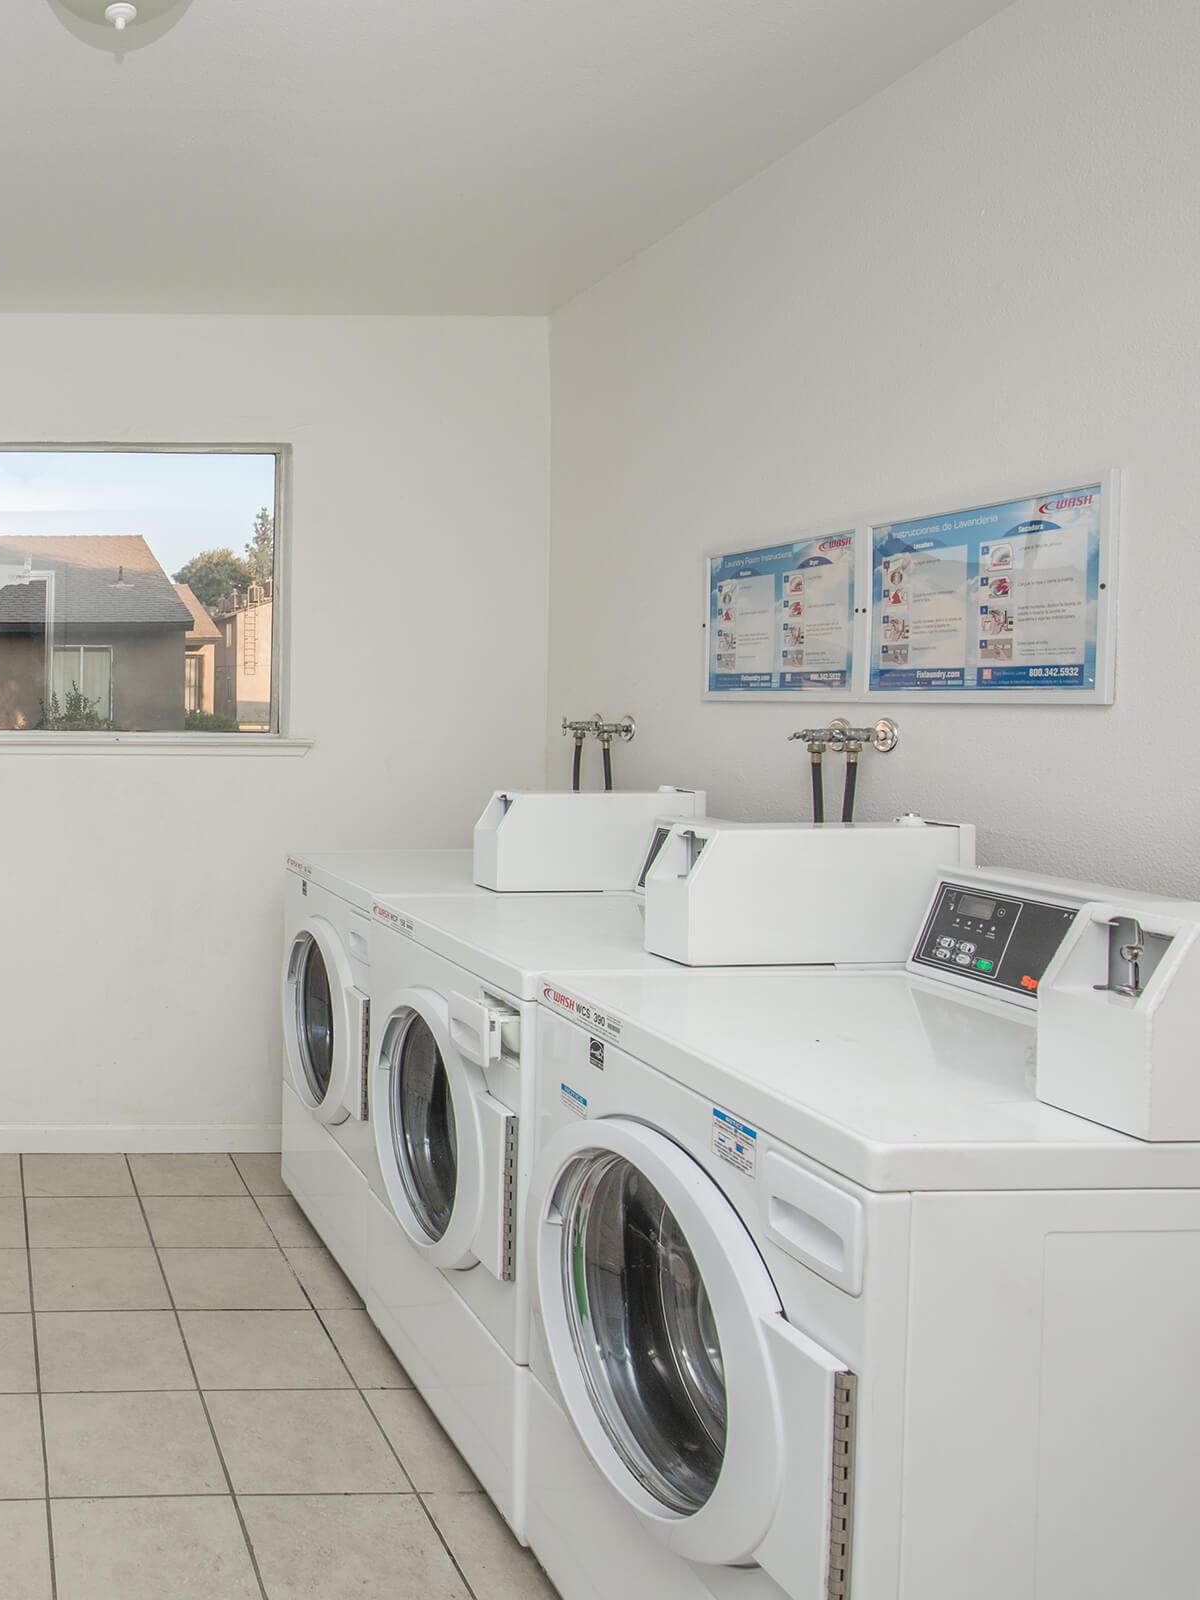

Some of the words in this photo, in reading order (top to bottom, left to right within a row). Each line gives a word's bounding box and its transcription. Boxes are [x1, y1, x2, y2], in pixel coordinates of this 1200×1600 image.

[1056, 494, 1093, 509] WASH
[942, 521, 952, 531] de
[829, 537, 853, 549] WASH
[725, 558, 745, 569] Laundry
[1029, 667, 1079, 678] 800.342.5932
[553, 991, 575, 1011] WASH
[576, 1002, 591, 1019] WCS
[593, 1012, 606, 1027] 390
